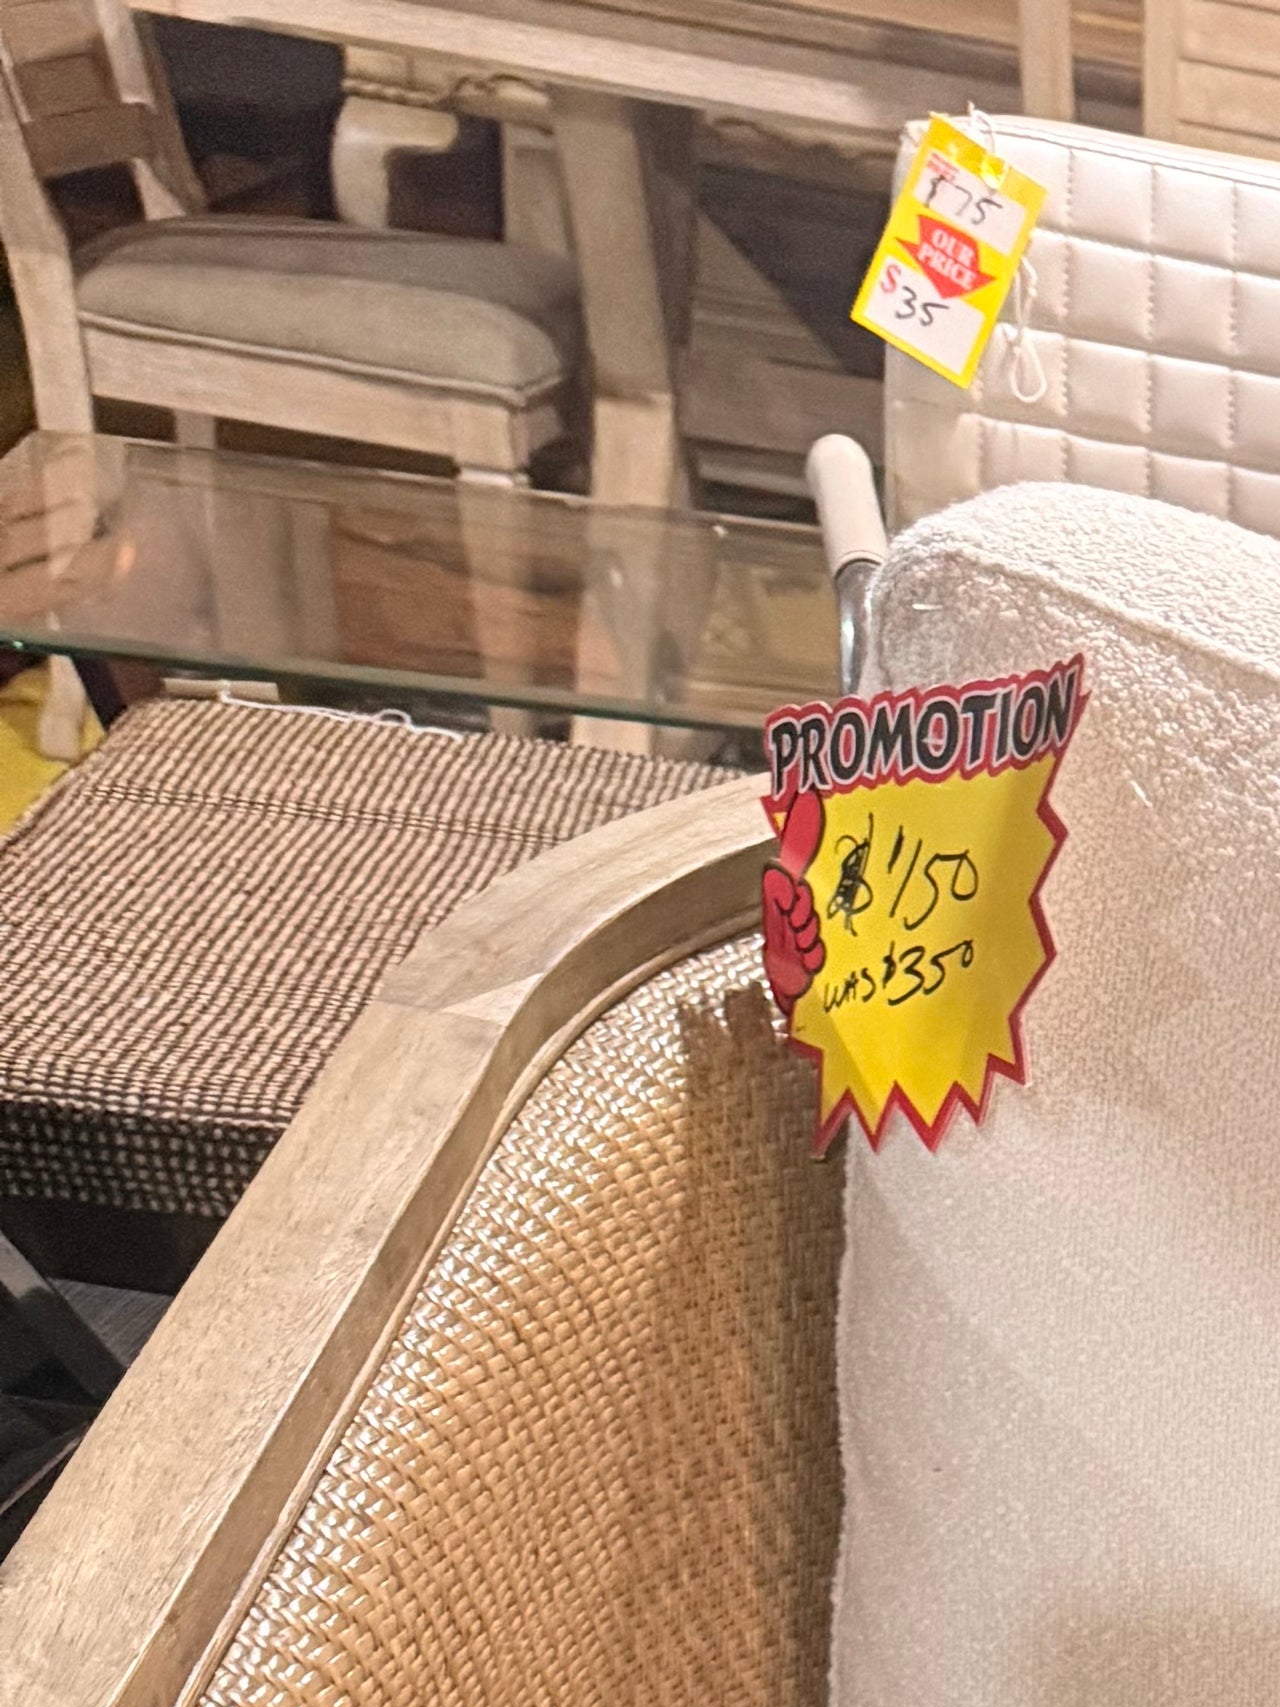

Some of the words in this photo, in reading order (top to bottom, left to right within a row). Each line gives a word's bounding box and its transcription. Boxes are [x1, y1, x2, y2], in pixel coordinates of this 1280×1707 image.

[916, 241, 978, 291] PRICE
[930, 227, 978, 265] OUR
[770, 670, 1079, 797] PROMOTION
